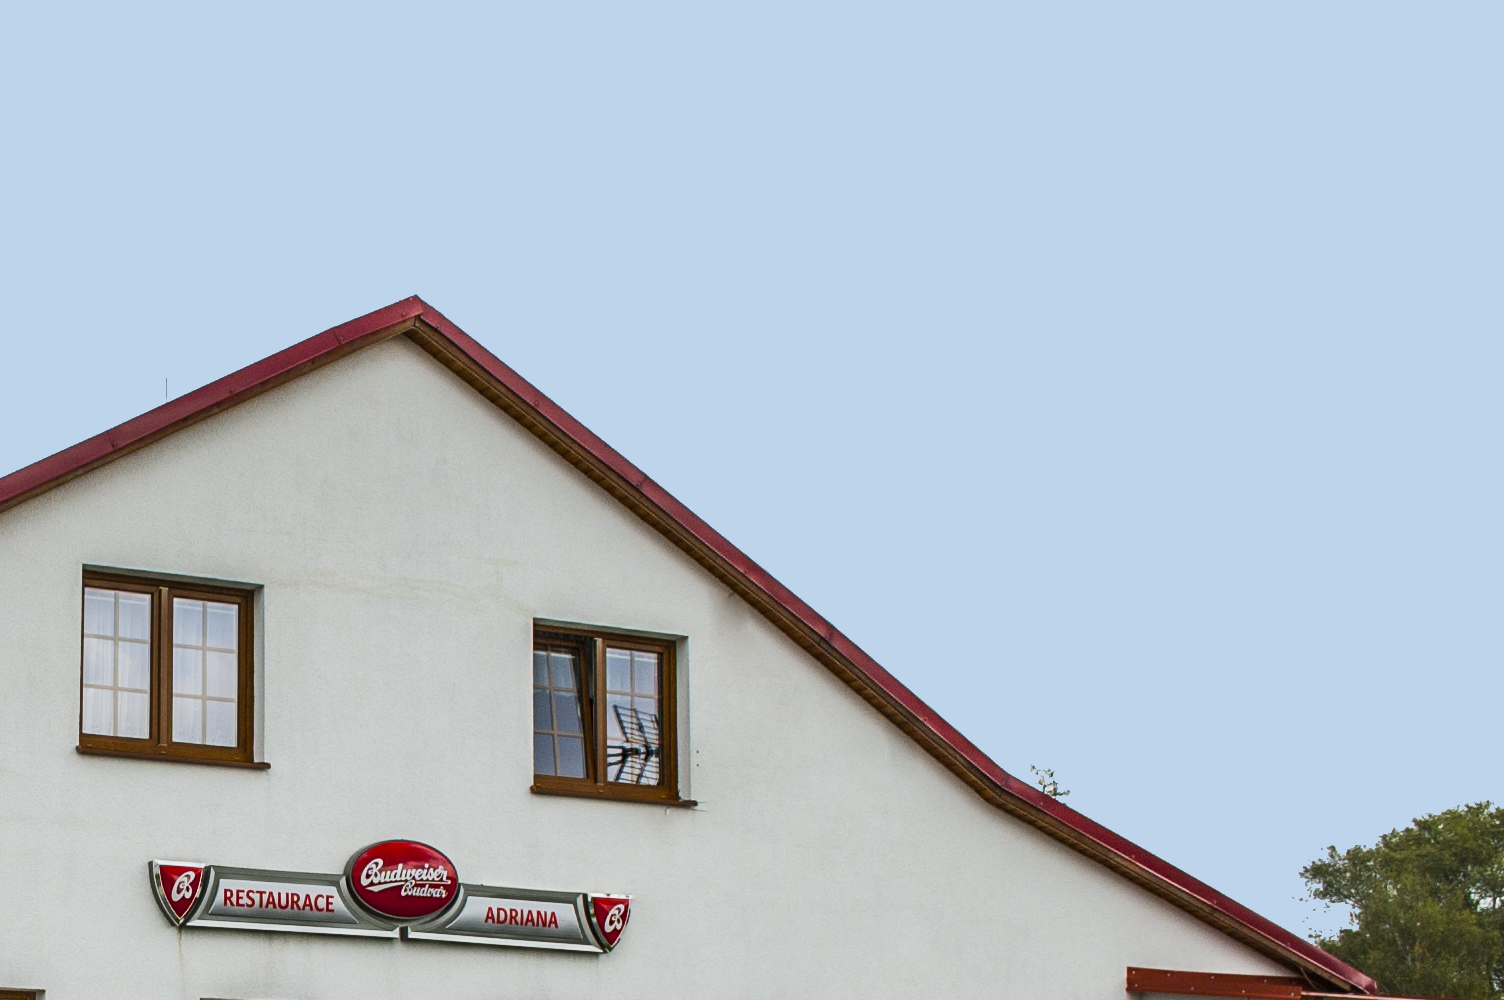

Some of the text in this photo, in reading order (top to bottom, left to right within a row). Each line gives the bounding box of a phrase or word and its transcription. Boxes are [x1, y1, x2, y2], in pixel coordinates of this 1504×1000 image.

[361, 858, 451, 893] Budweiser
[223, 888, 335, 913] RESTAURACE
[401, 880, 448, 898] Budvar
[484, 906, 559, 929] ADRIANA
